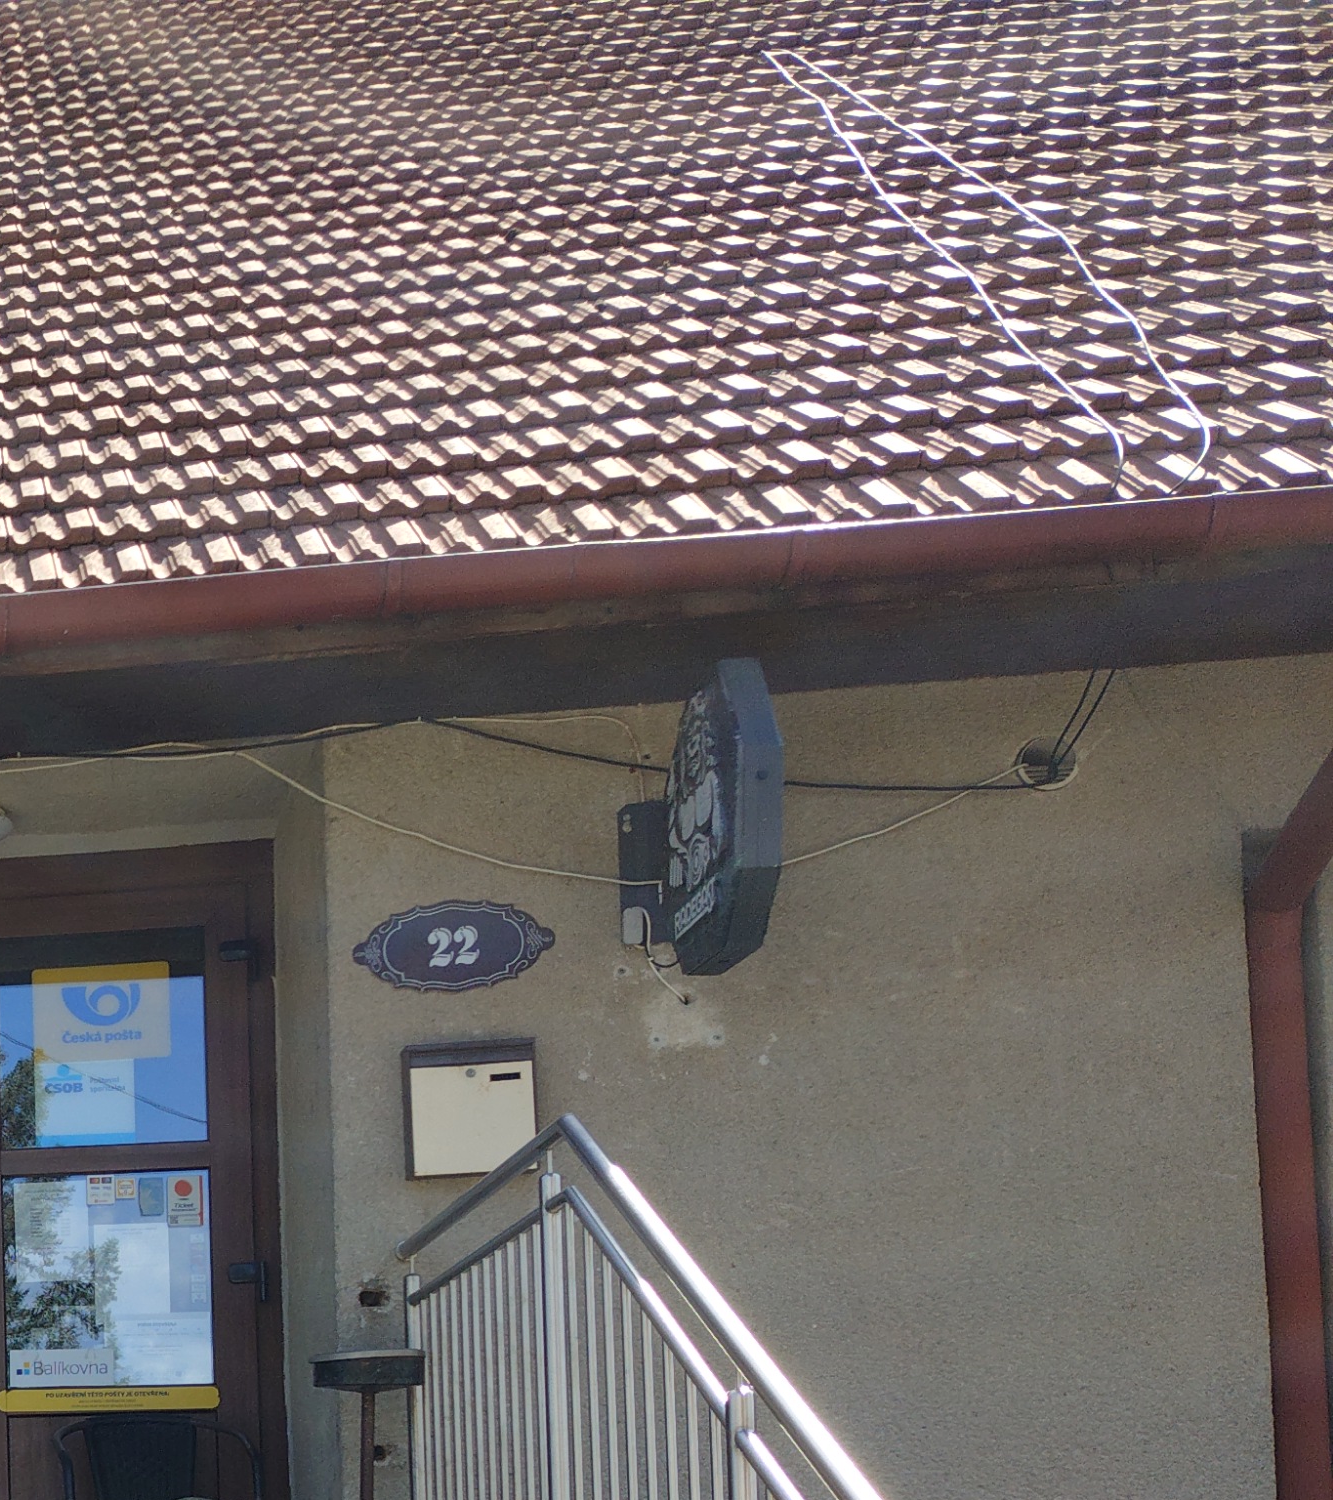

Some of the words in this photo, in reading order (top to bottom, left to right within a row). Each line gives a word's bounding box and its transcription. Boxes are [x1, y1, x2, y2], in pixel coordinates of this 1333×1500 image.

[427, 925, 480, 967] 22
[61, 1030, 101, 1044] Česká
[104, 1029, 143, 1043] pošta
[44, 1082, 84, 1094] ČSOB
[33, 1361, 108, 1376] Balíkovna
